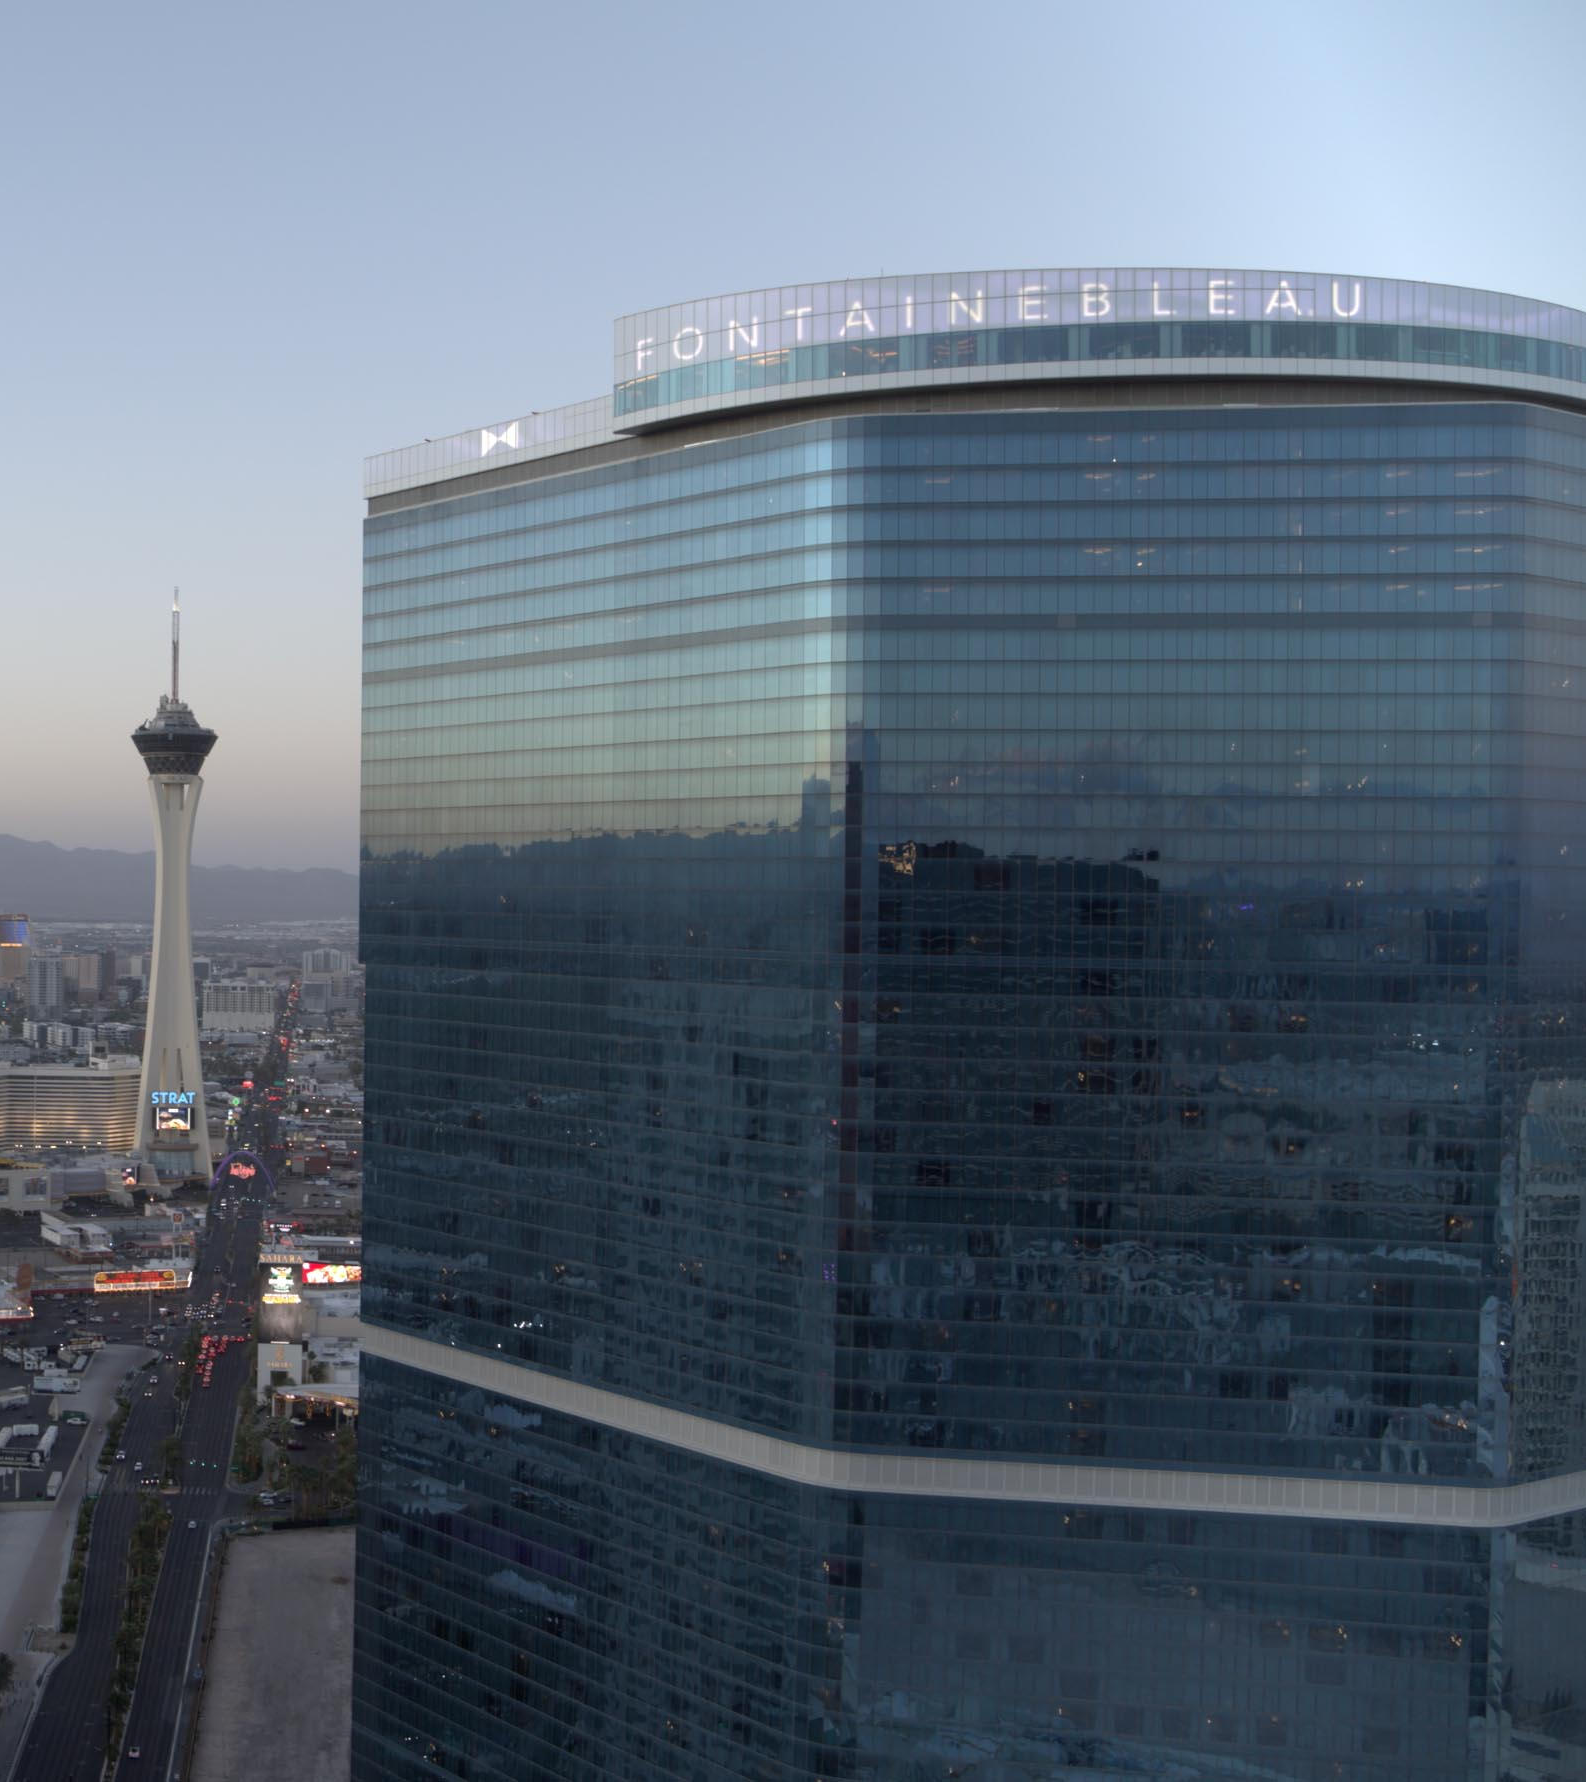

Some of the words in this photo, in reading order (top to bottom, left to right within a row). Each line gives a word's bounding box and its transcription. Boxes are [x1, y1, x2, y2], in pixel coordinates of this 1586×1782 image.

[637, 279, 1361, 371] FONTAINEBLEAU
[151, 1091, 195, 1104] STRAT
[259, 1253, 303, 1263] SAHARA
